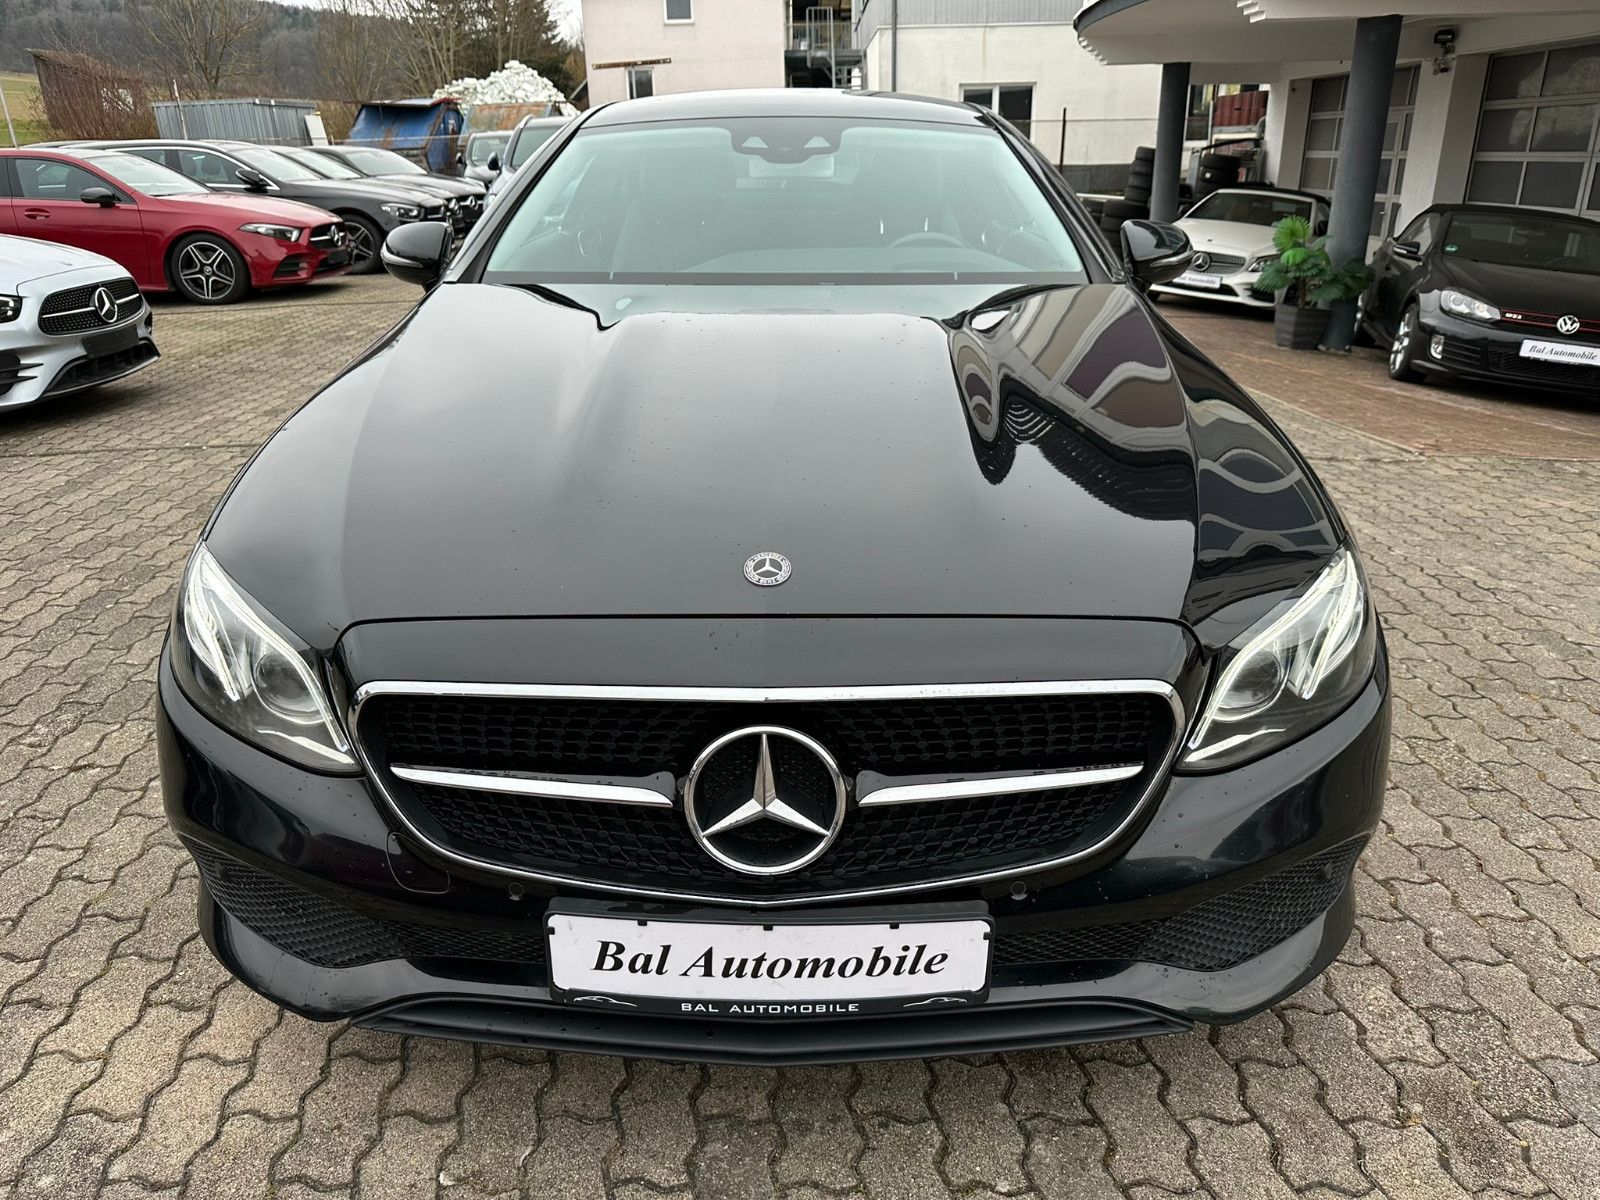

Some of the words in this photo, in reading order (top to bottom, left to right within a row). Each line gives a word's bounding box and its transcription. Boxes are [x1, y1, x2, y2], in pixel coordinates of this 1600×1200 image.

[1528, 344, 1545, 354] Bal
[1546, 346, 1598, 360] Automobile
[590, 939, 671, 976] Bal
[680, 943, 949, 979] Automobile
[681, 1003, 719, 1013] BAL
[729, 1003, 860, 1014] AUTOMOBILE
